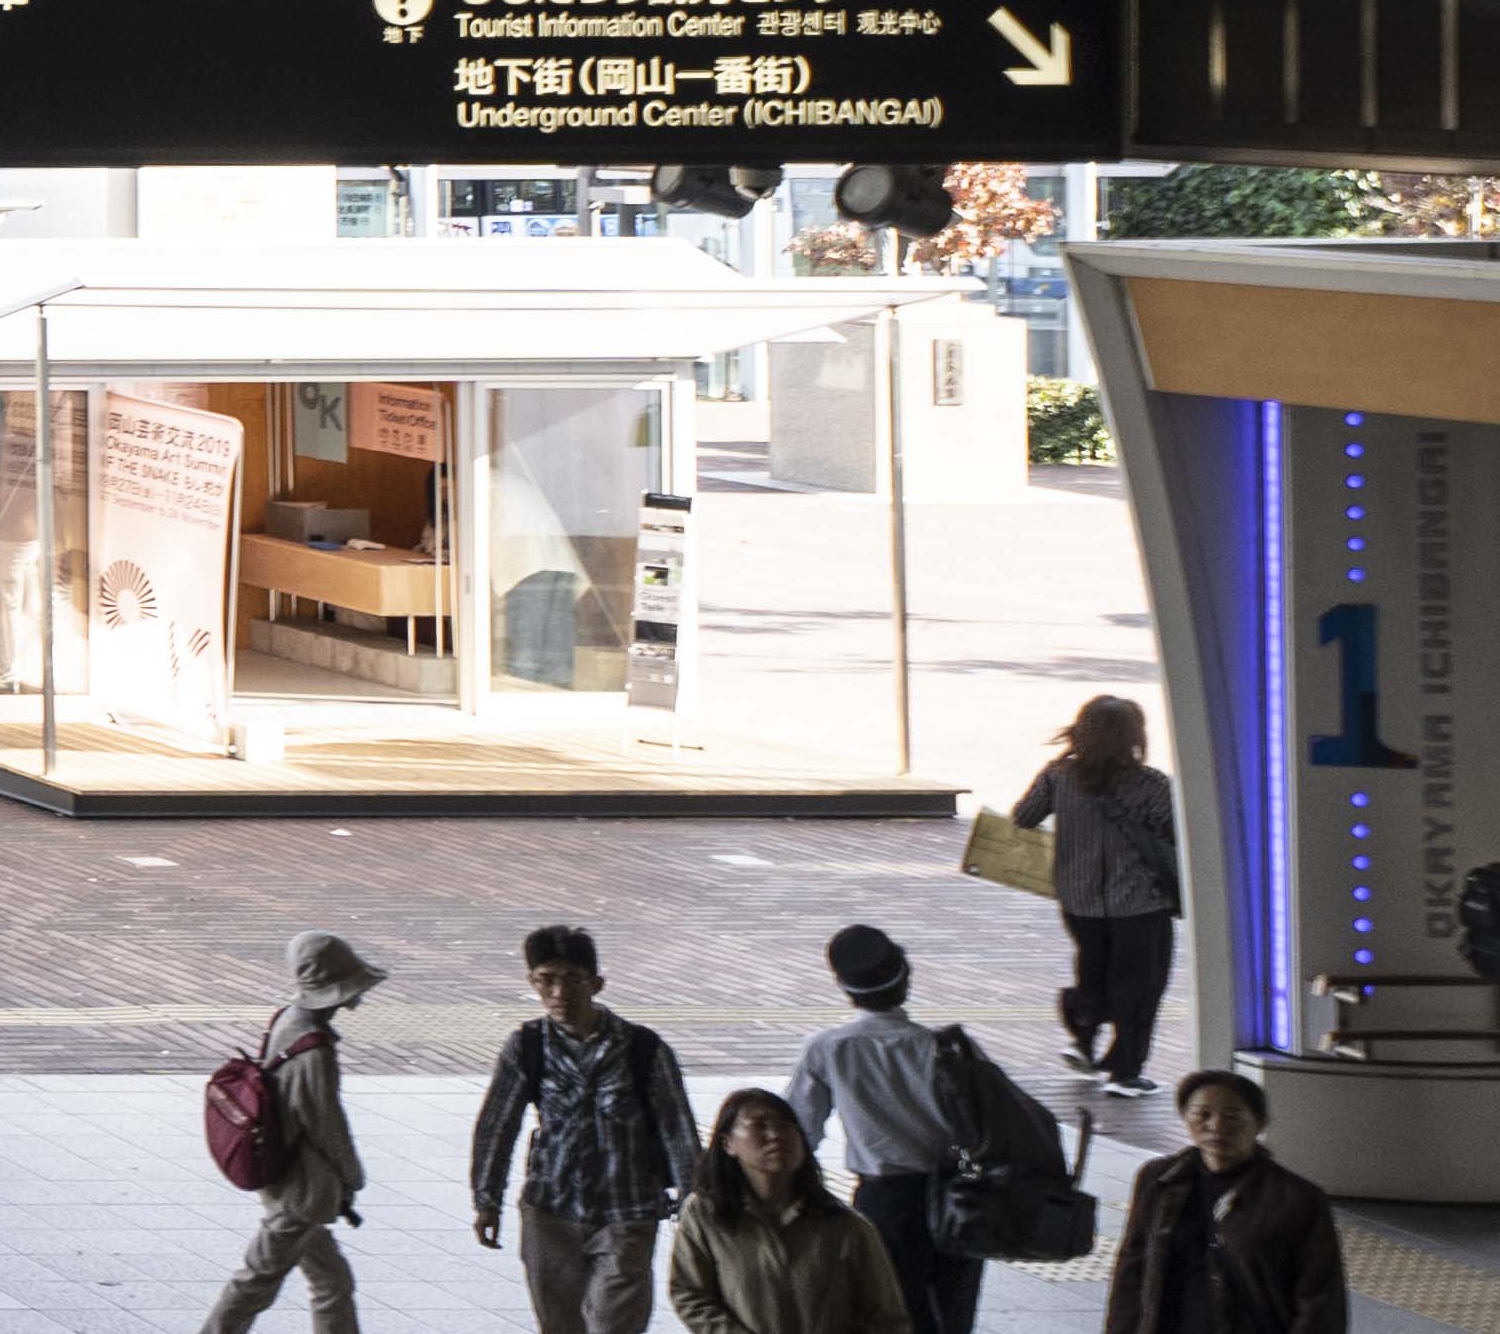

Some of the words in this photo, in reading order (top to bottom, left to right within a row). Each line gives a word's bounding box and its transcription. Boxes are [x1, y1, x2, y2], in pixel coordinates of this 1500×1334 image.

[384, 26, 425, 44] 地下
[455, 12, 533, 38] Tourist
[538, 12, 663, 38] Information
[667, 12, 742, 38] Center
[454, 57, 811, 97] 地下街(岡山一番街)
[457, 101, 638, 132] Underground
[645, 101, 734, 127] Center
[743, 99, 943, 130] (ICHIBANGAI)
[1416, 430, 1452, 697] ICHIBANGAI
[1424, 714, 1459, 941] OKAYAMA
